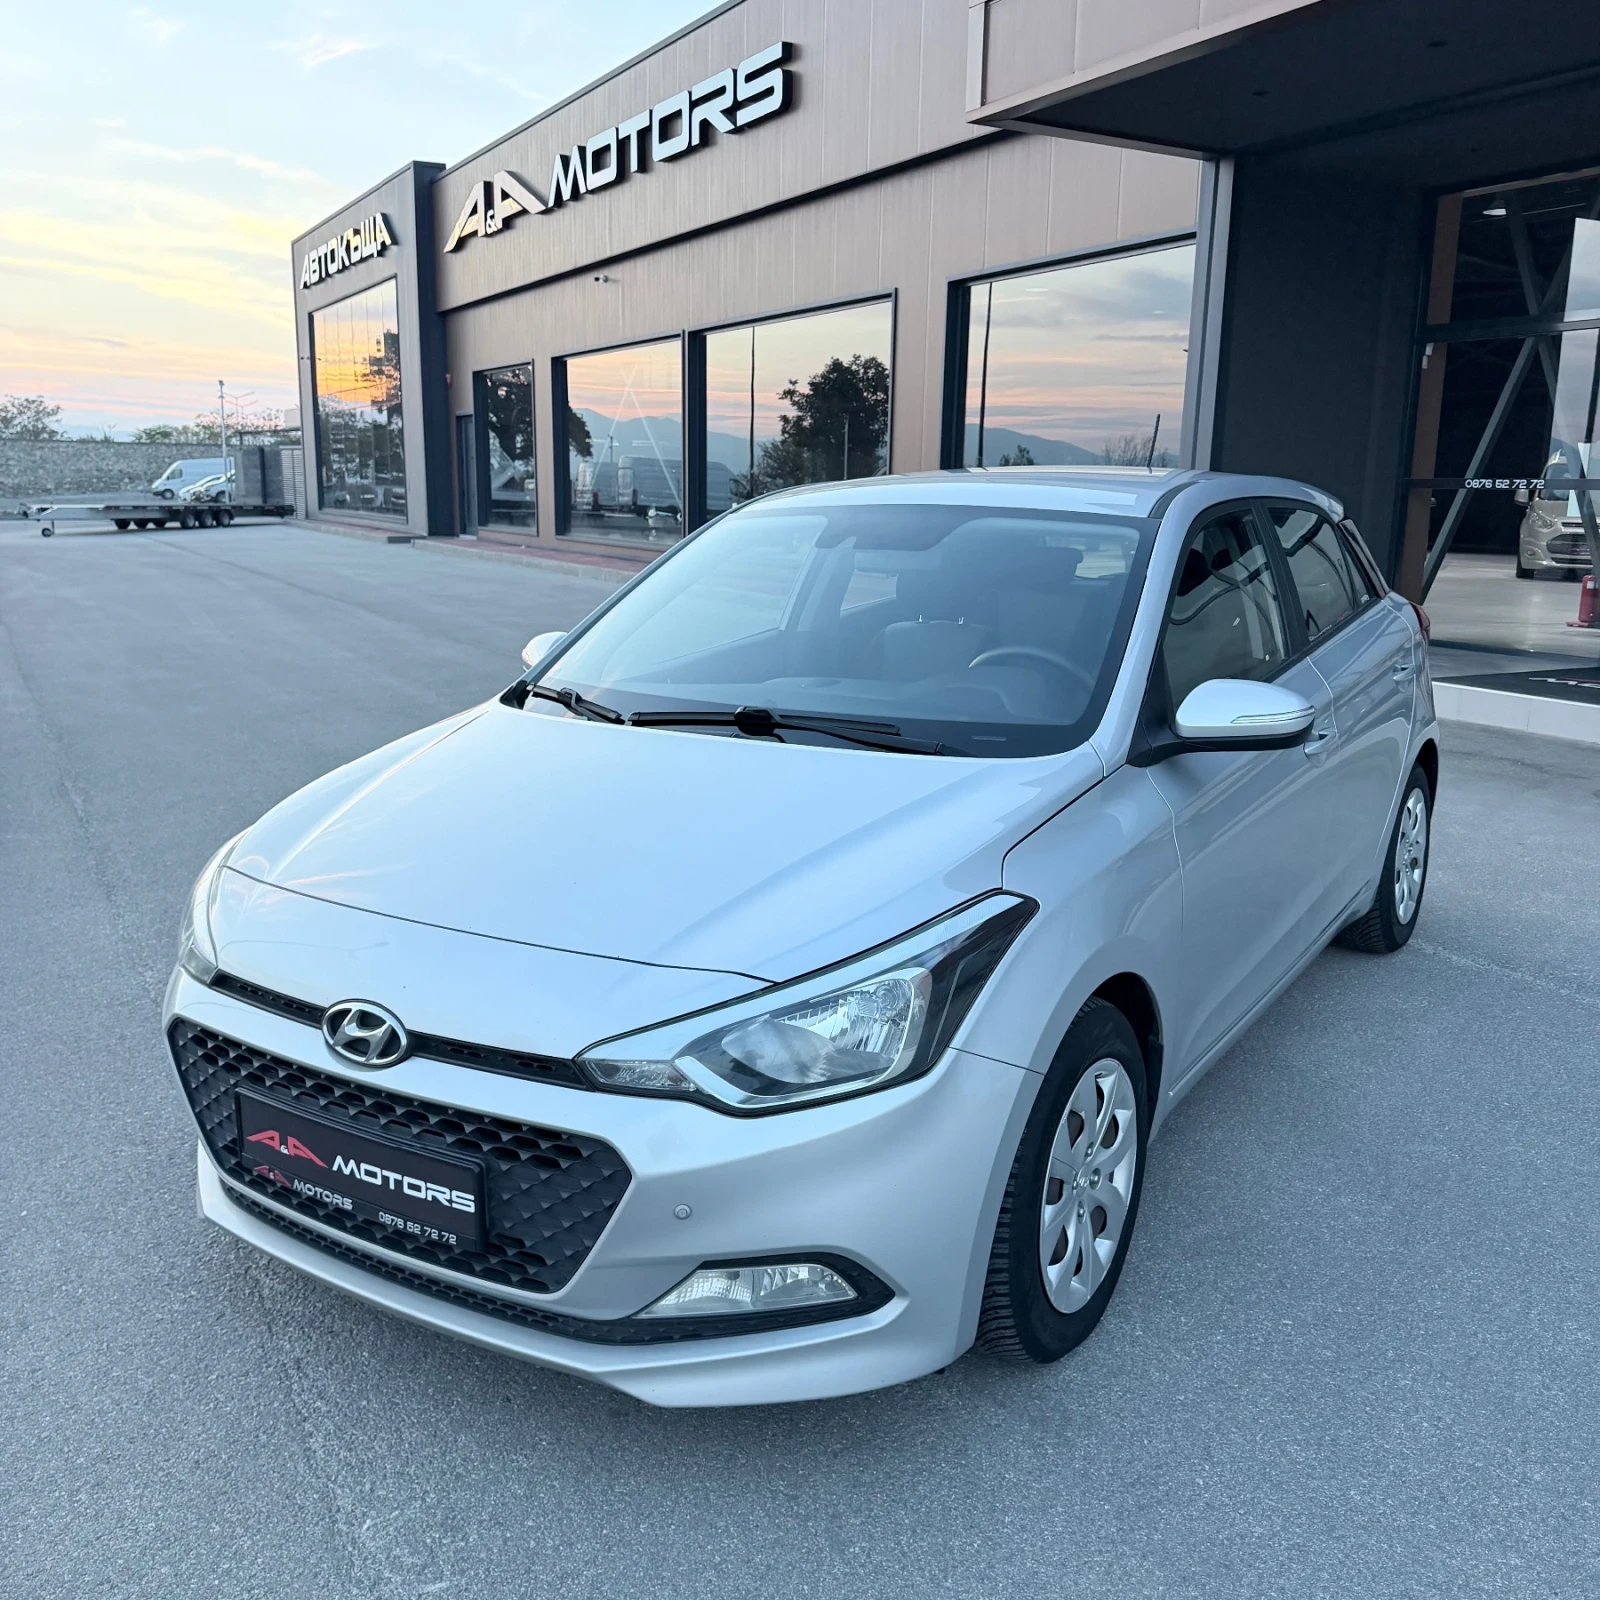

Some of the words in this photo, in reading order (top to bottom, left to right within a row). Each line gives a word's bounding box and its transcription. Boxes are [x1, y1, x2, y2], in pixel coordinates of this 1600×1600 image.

[443, 169, 547, 254] A&A
[548, 41, 784, 208] MOTORS
[300, 212, 392, 290] АВТОКЪЩА
[1464, 478, 1493, 489] 0876
[1511, 478, 1527, 489] 72
[1529, 478, 1545, 489] 72
[246, 1129, 329, 1169] A&A
[332, 1155, 476, 1213] MOTORS
[253, 1165, 292, 1188] A&A
[293, 1179, 353, 1211] MOTORS
[378, 1211, 405, 1229] 0876
[423, 1226, 439, 1240] 72
[441, 1231, 457, 1245] 72
